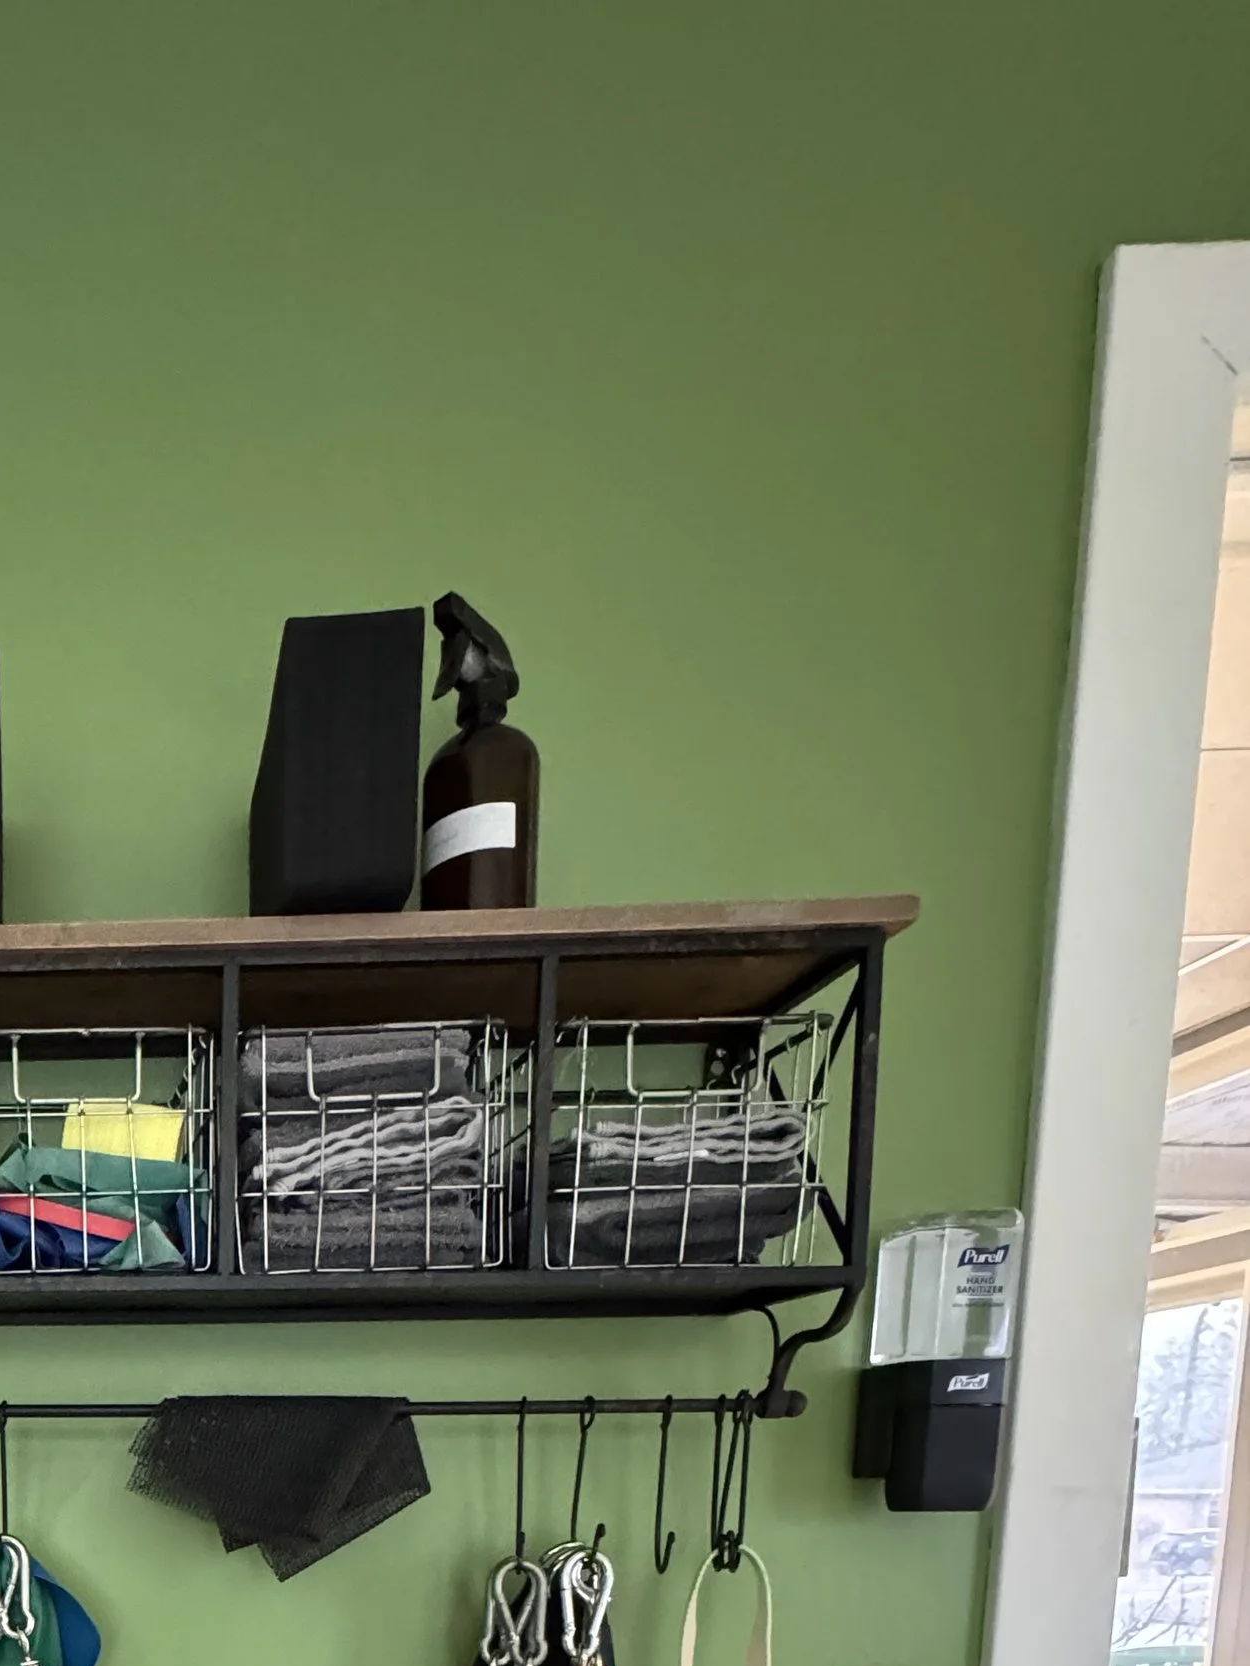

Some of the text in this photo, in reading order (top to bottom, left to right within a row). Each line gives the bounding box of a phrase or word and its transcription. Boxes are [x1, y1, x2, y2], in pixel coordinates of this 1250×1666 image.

[964, 1249, 1005, 1264] Purell
[956, 1285, 1004, 1294] SANITIZER
[953, 1376, 985, 1389] Purell
